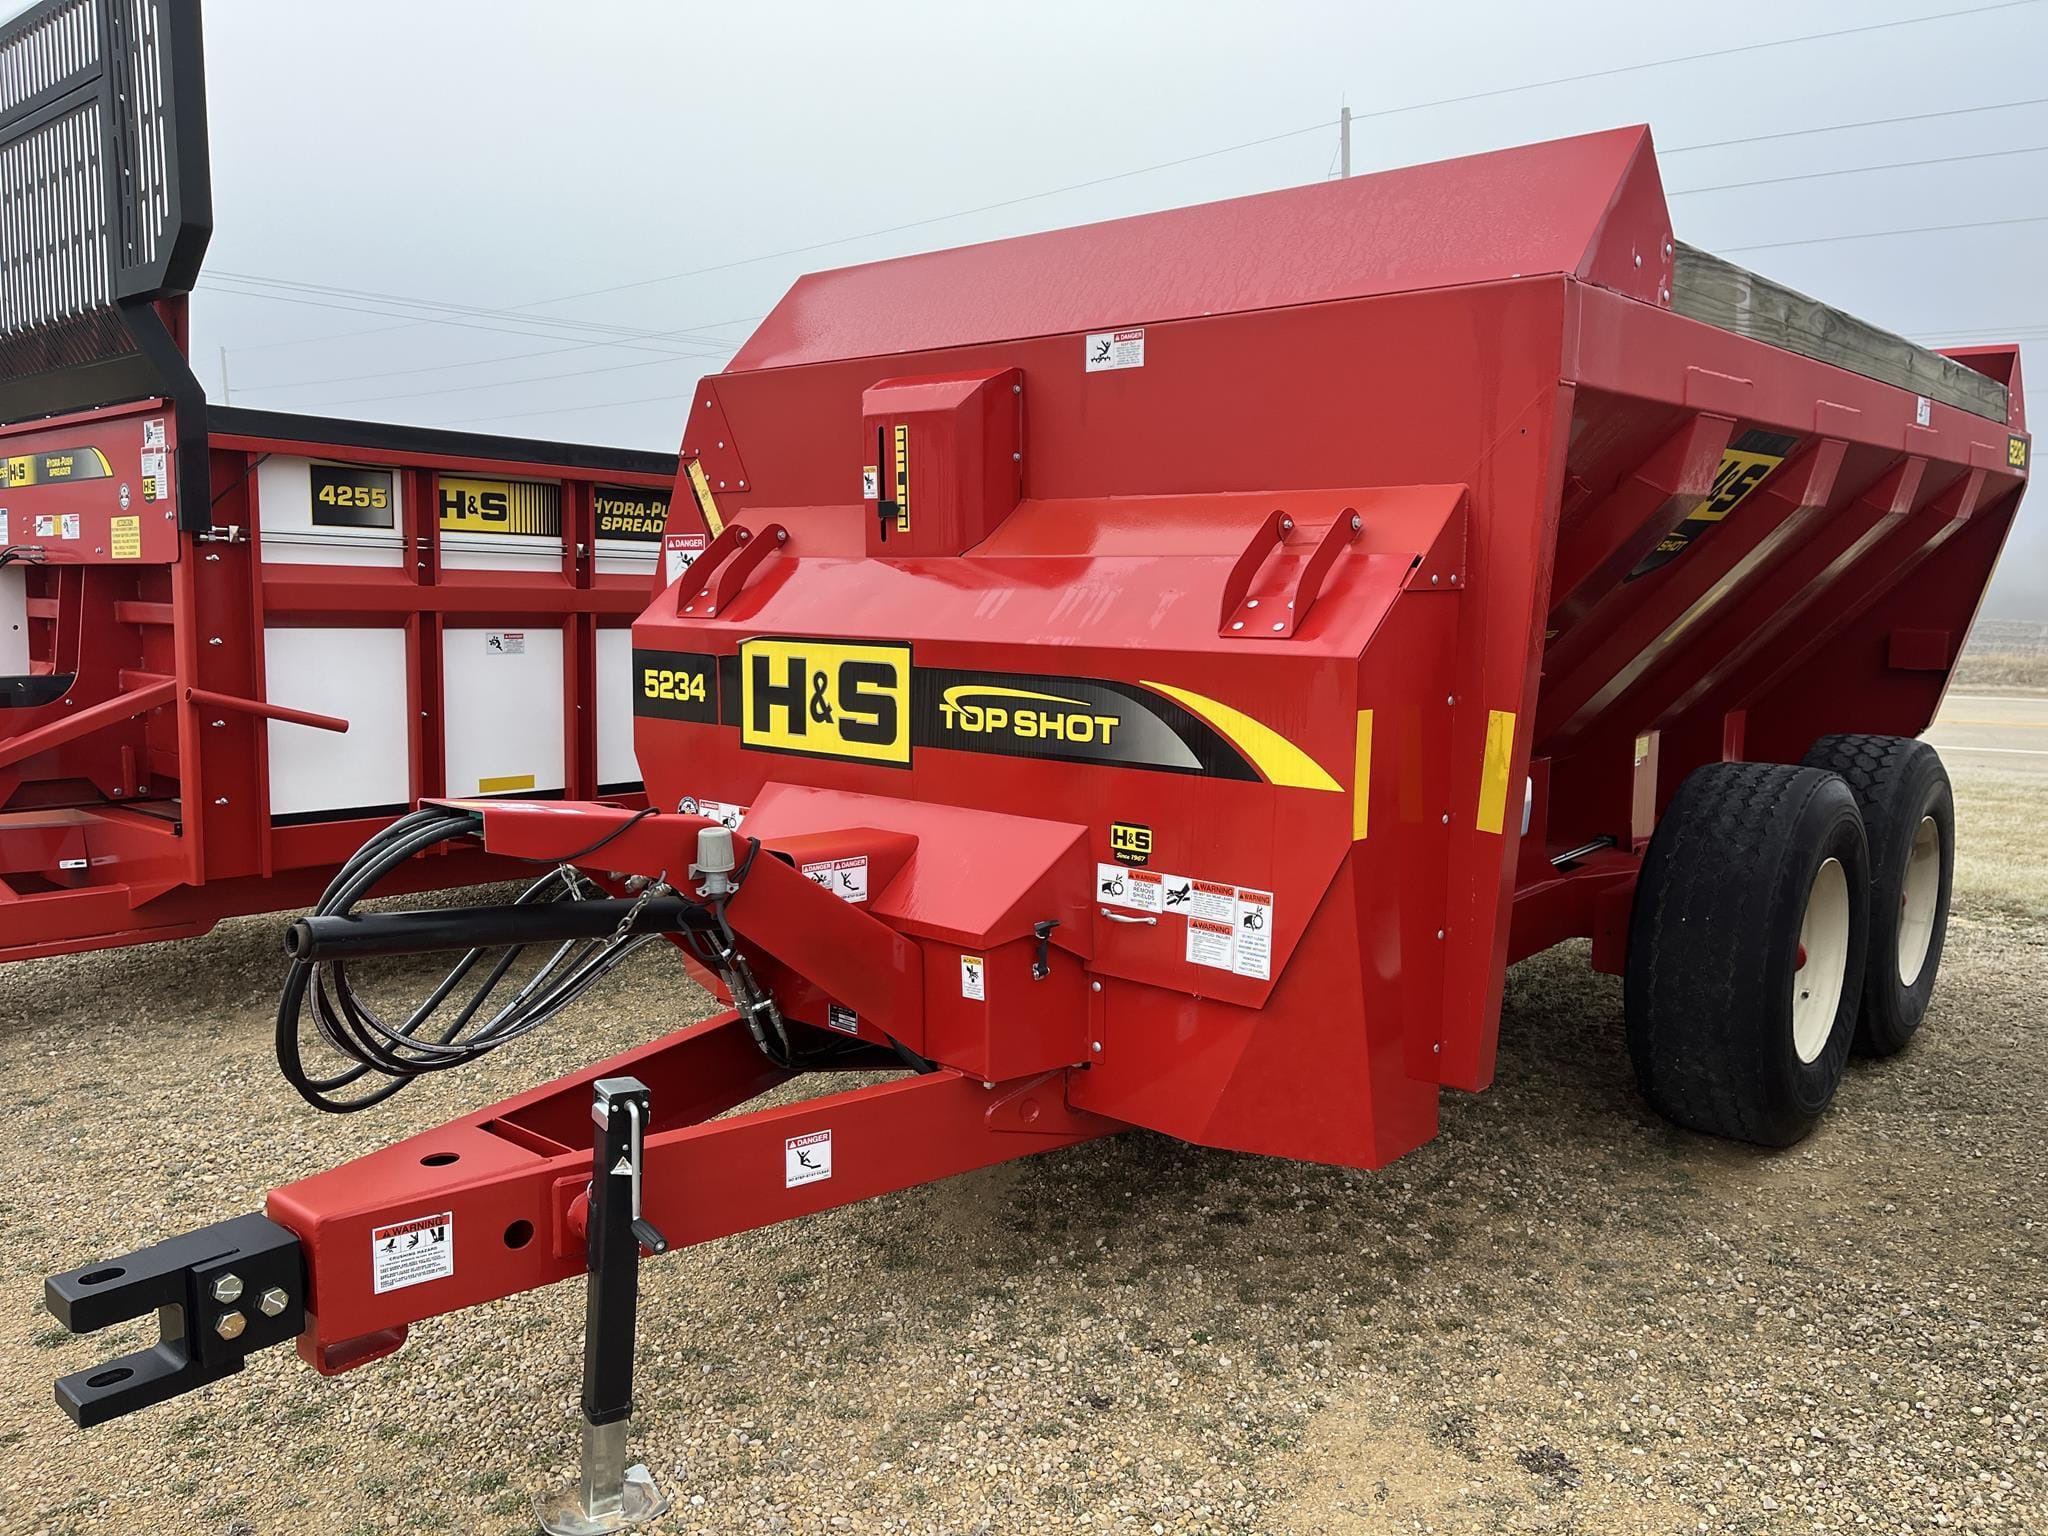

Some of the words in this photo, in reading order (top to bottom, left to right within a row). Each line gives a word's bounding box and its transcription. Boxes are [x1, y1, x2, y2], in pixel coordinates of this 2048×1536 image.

[319, 485, 388, 508] 4255
[439, 489, 508, 522] H&S
[594, 497, 668, 518] HYDRA-PU
[601, 517, 664, 533] SPREAD
[675, 539, 703, 548] DANGER
[644, 669, 706, 702] 5234
[753, 654, 898, 746] H&S
[939, 702, 1008, 734] TOP
[1014, 710, 1119, 745] SHOT
[1113, 828, 1150, 850] H&S
[841, 859, 866, 868] DANGER
[1200, 884, 1233, 896] WARNING
[1244, 894, 1270, 904] WARNING
[1199, 922, 1230, 934] WARNING
[797, 1133, 828, 1147] DANGER
[393, 1216, 444, 1236] WARNING
